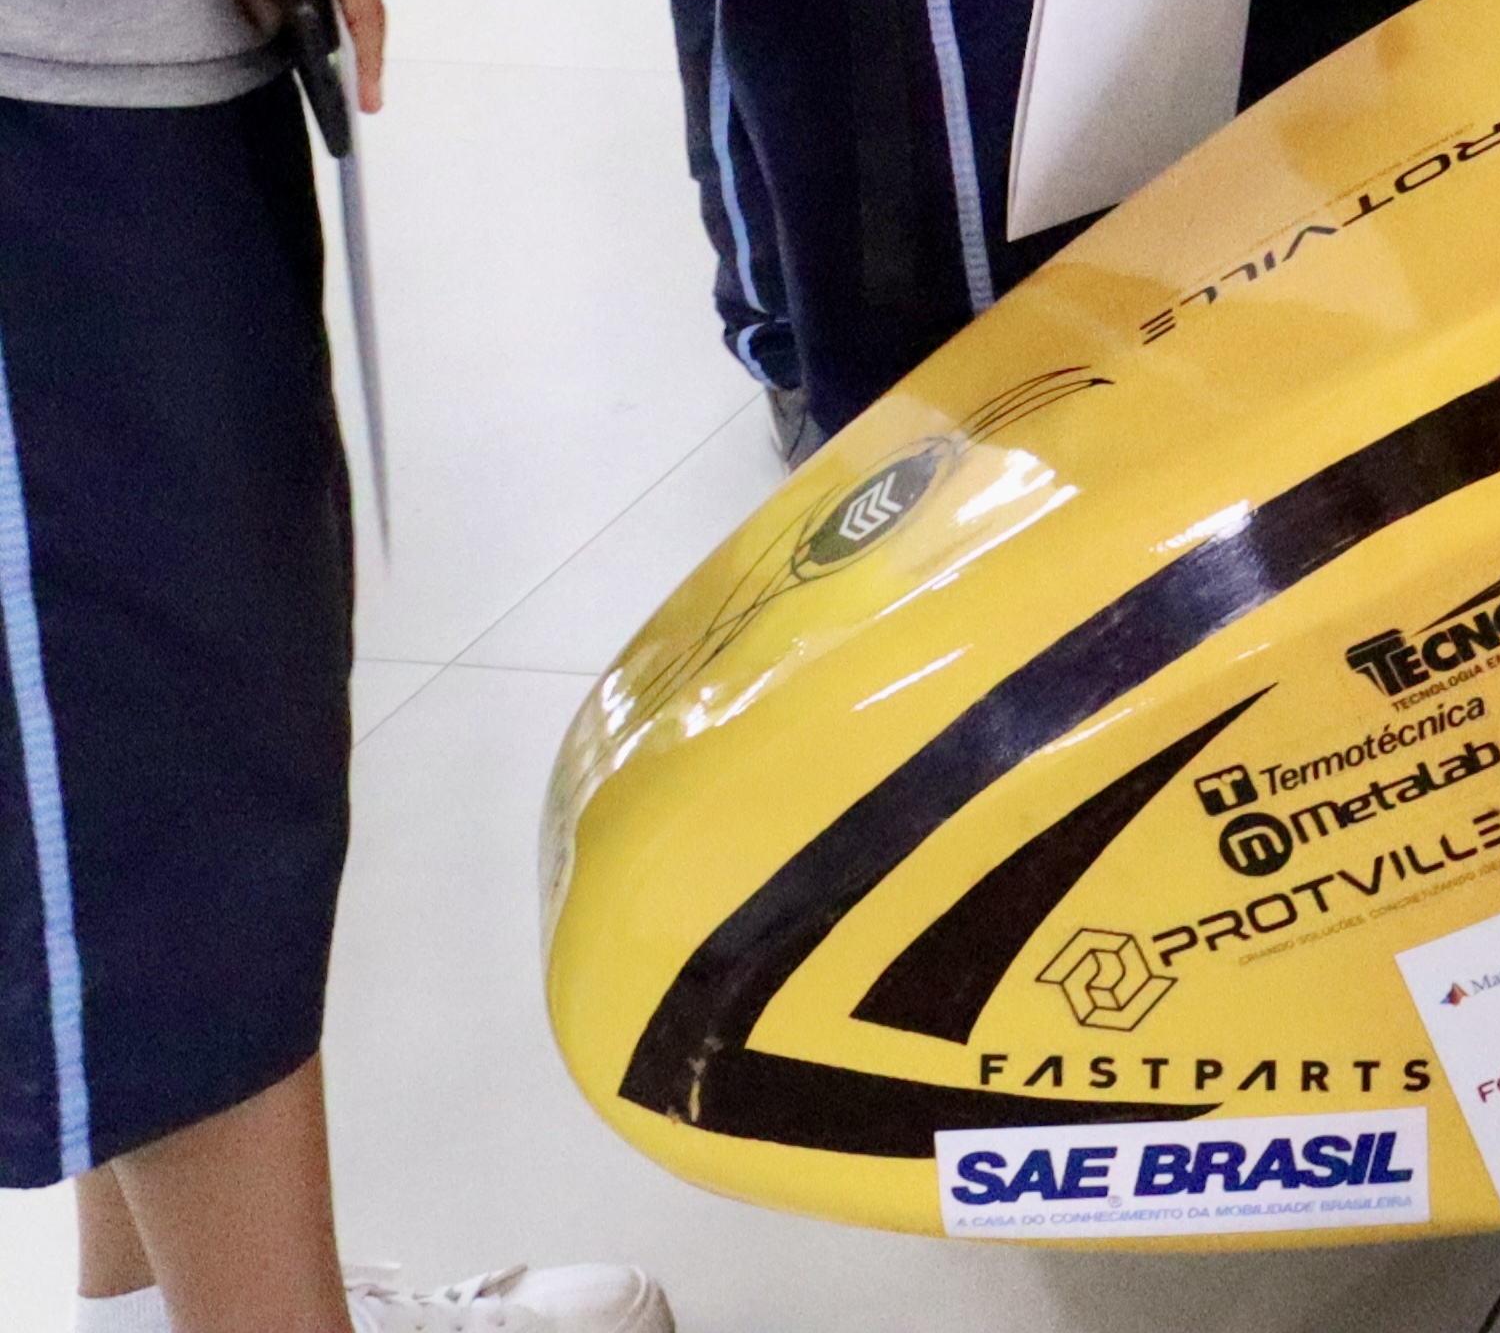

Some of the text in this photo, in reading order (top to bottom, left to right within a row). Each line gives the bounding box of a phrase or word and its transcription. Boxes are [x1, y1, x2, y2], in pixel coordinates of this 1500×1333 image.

[1391, 663, 1483, 713] TECNOLOGIA
[1261, 694, 1486, 797] Termotécnica
[951, 1131, 1413, 1206] SAE BRASIL
[971, 1214, 1018, 1228] CASA
[1021, 1213, 1046, 1226] DO
[1050, 1206, 1184, 1224] CONHECIMENTO
[1186, 1205, 1213, 1220] DA
[1214, 1199, 1318, 1219] MOBILIDADE
[1320, 1194, 1413, 1213] BRASILEIRA
